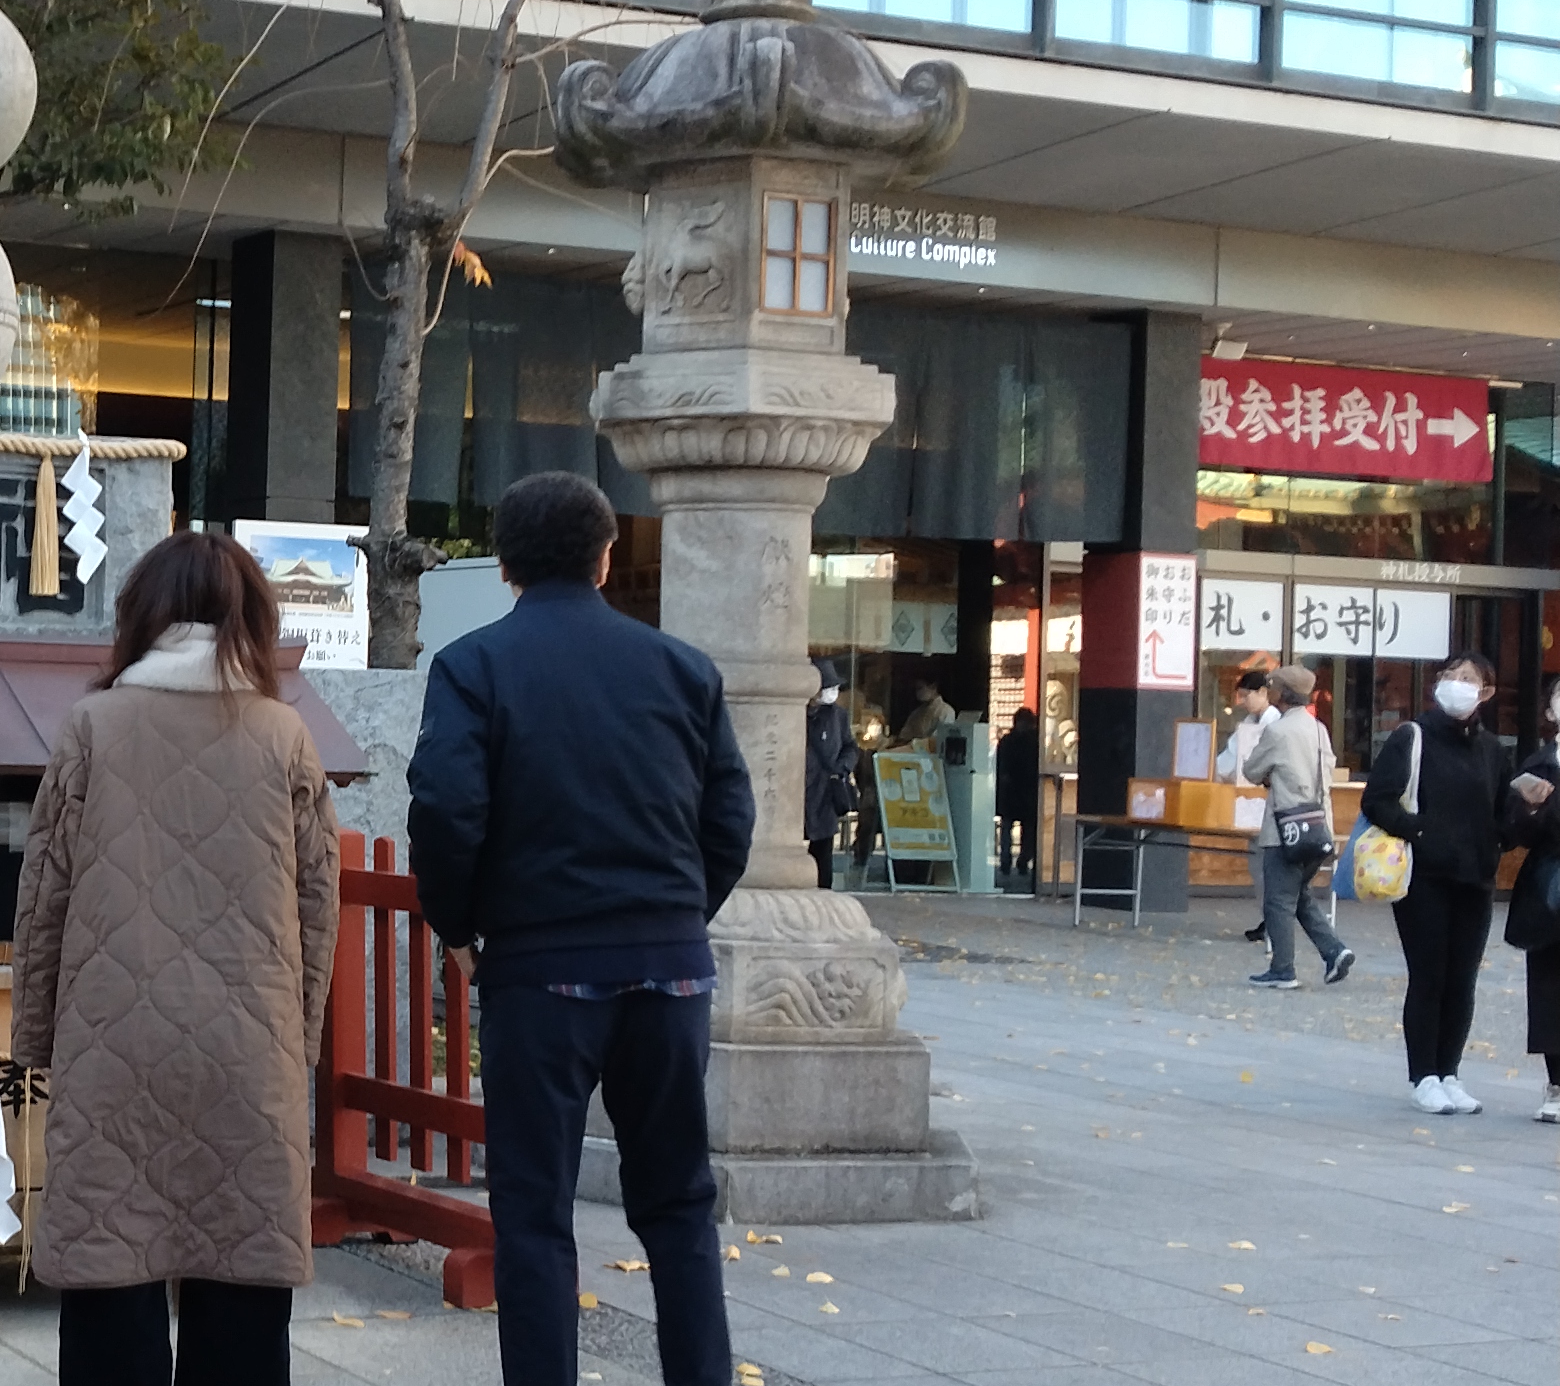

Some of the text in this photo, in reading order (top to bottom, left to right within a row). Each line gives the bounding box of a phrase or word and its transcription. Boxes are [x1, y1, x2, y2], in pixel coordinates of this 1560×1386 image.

[850, 201, 997, 242] 明神文化交流館
[850, 230, 997, 269] Culture Complex
[1162, 564, 1176, 625] お守り
